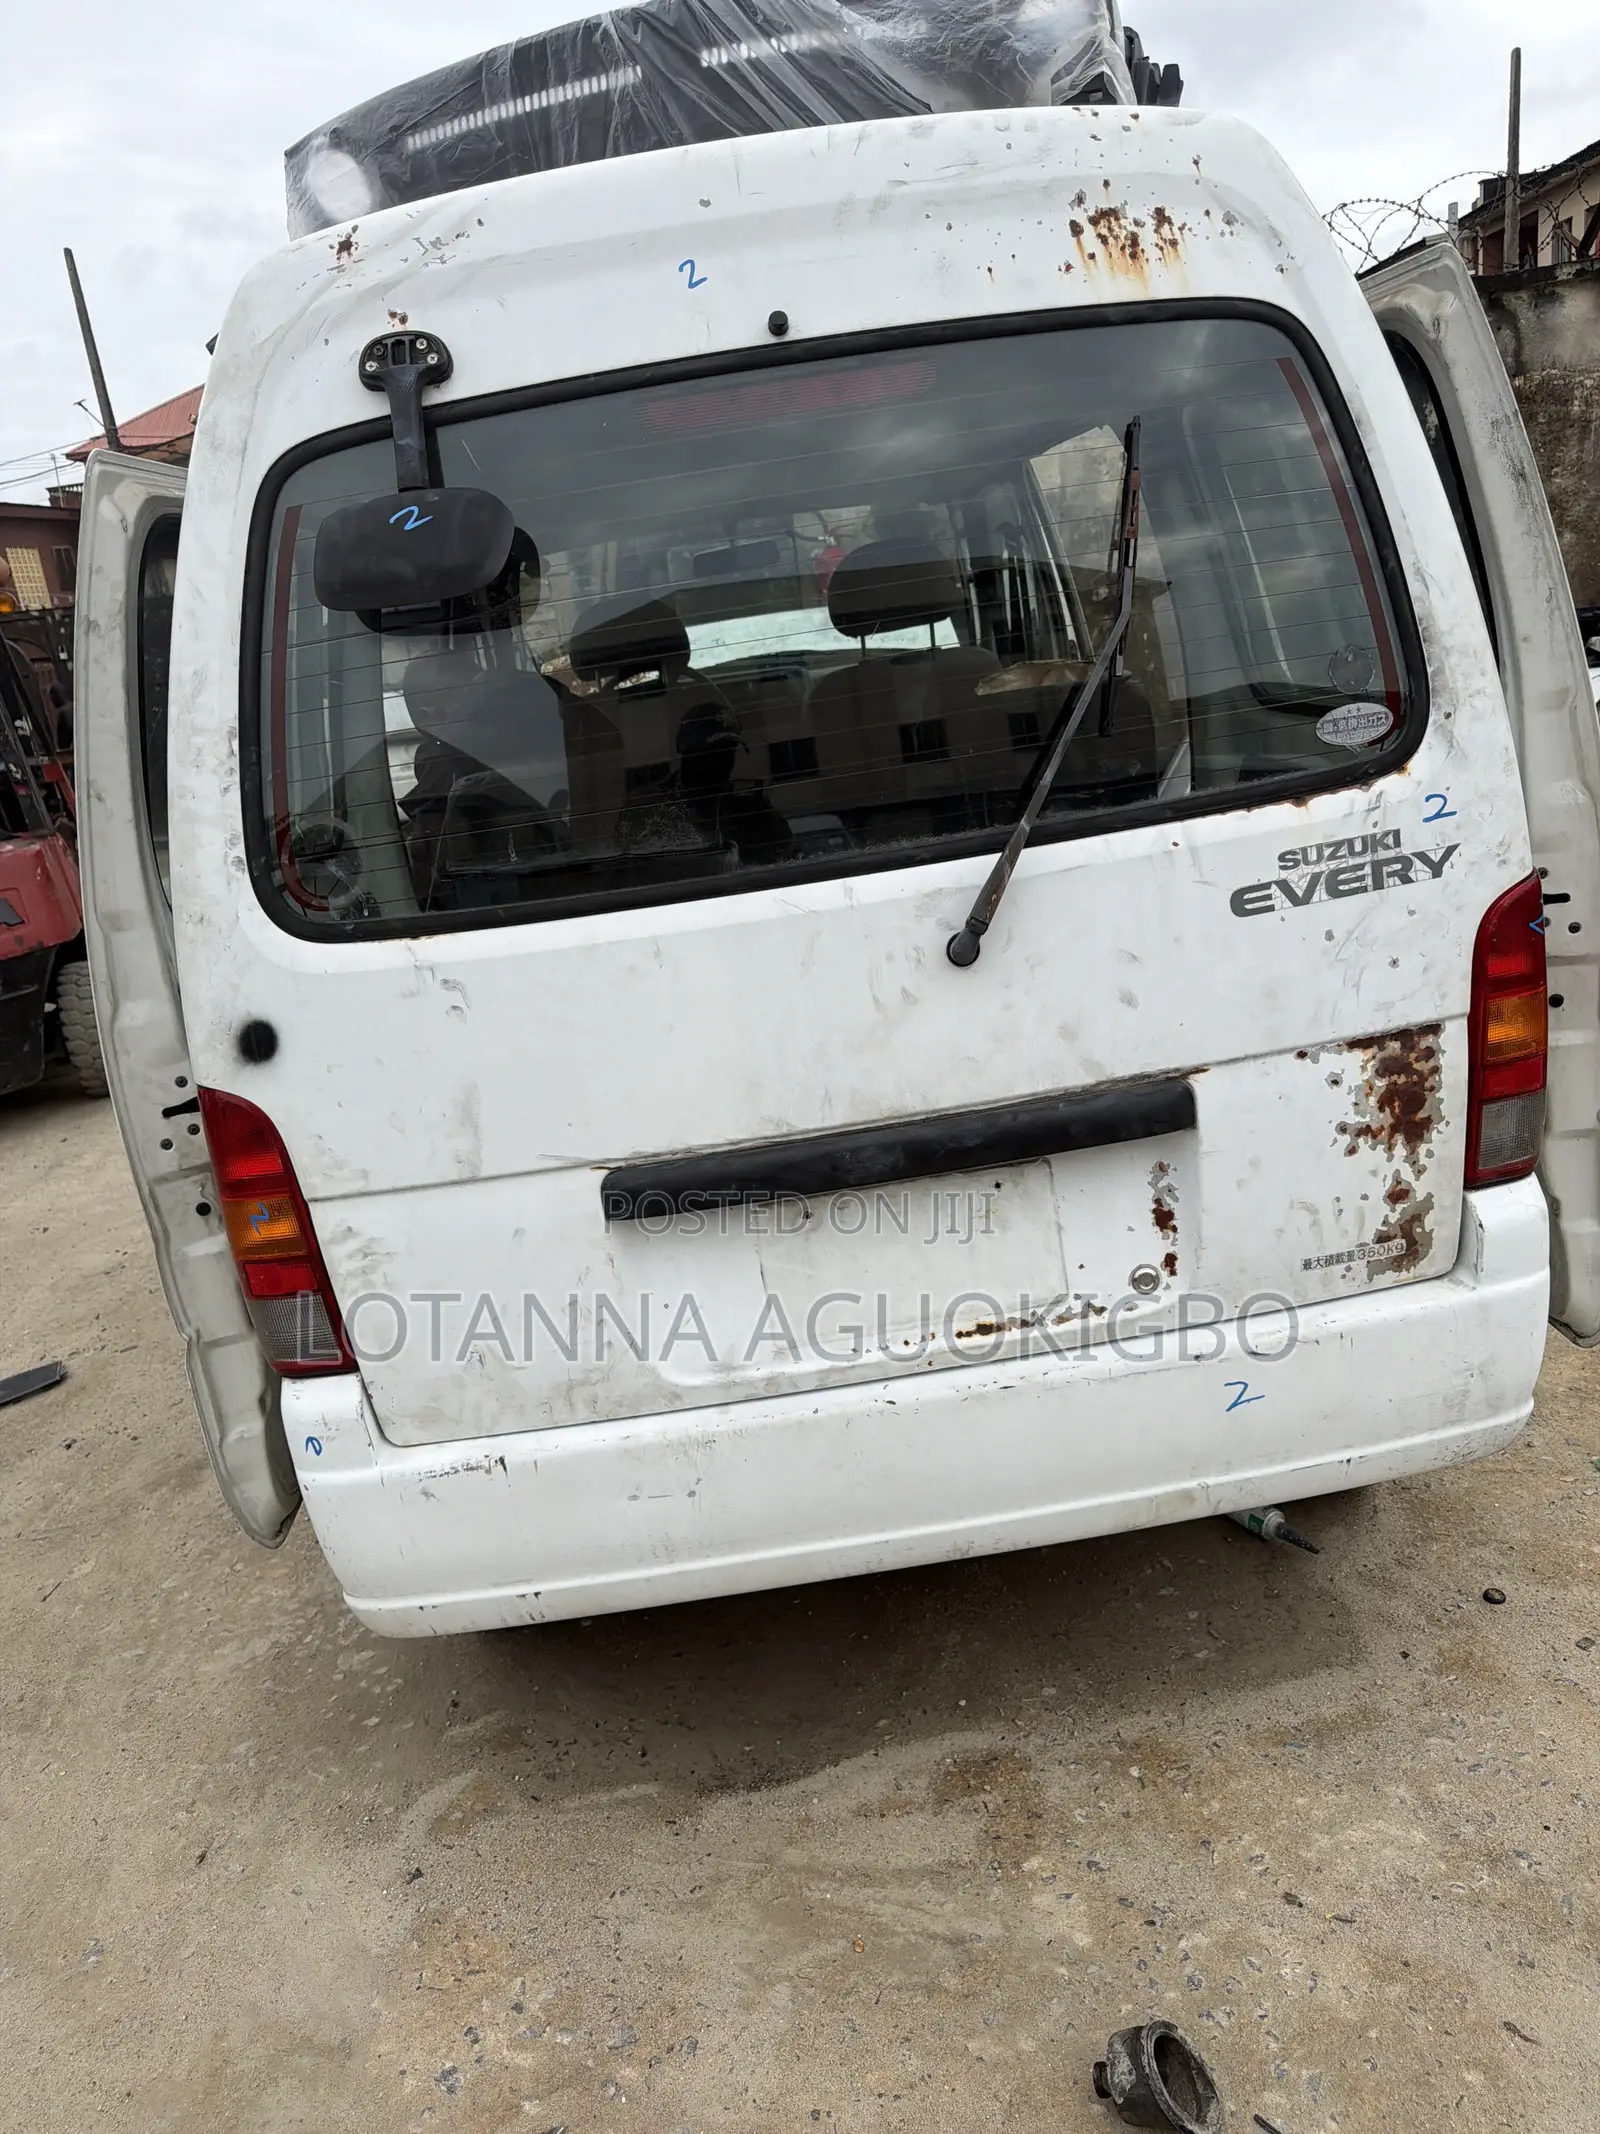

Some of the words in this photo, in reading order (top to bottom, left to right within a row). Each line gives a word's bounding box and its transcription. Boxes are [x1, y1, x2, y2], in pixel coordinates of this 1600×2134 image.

[678, 259, 707, 289] 2
[389, 505, 434, 531] 2
[1422, 793, 1458, 823] 2
[1277, 828, 1402, 871] SUZUKI
[1229, 842, 1461, 918] EVERY
[1223, 1380, 1266, 1413] 2
